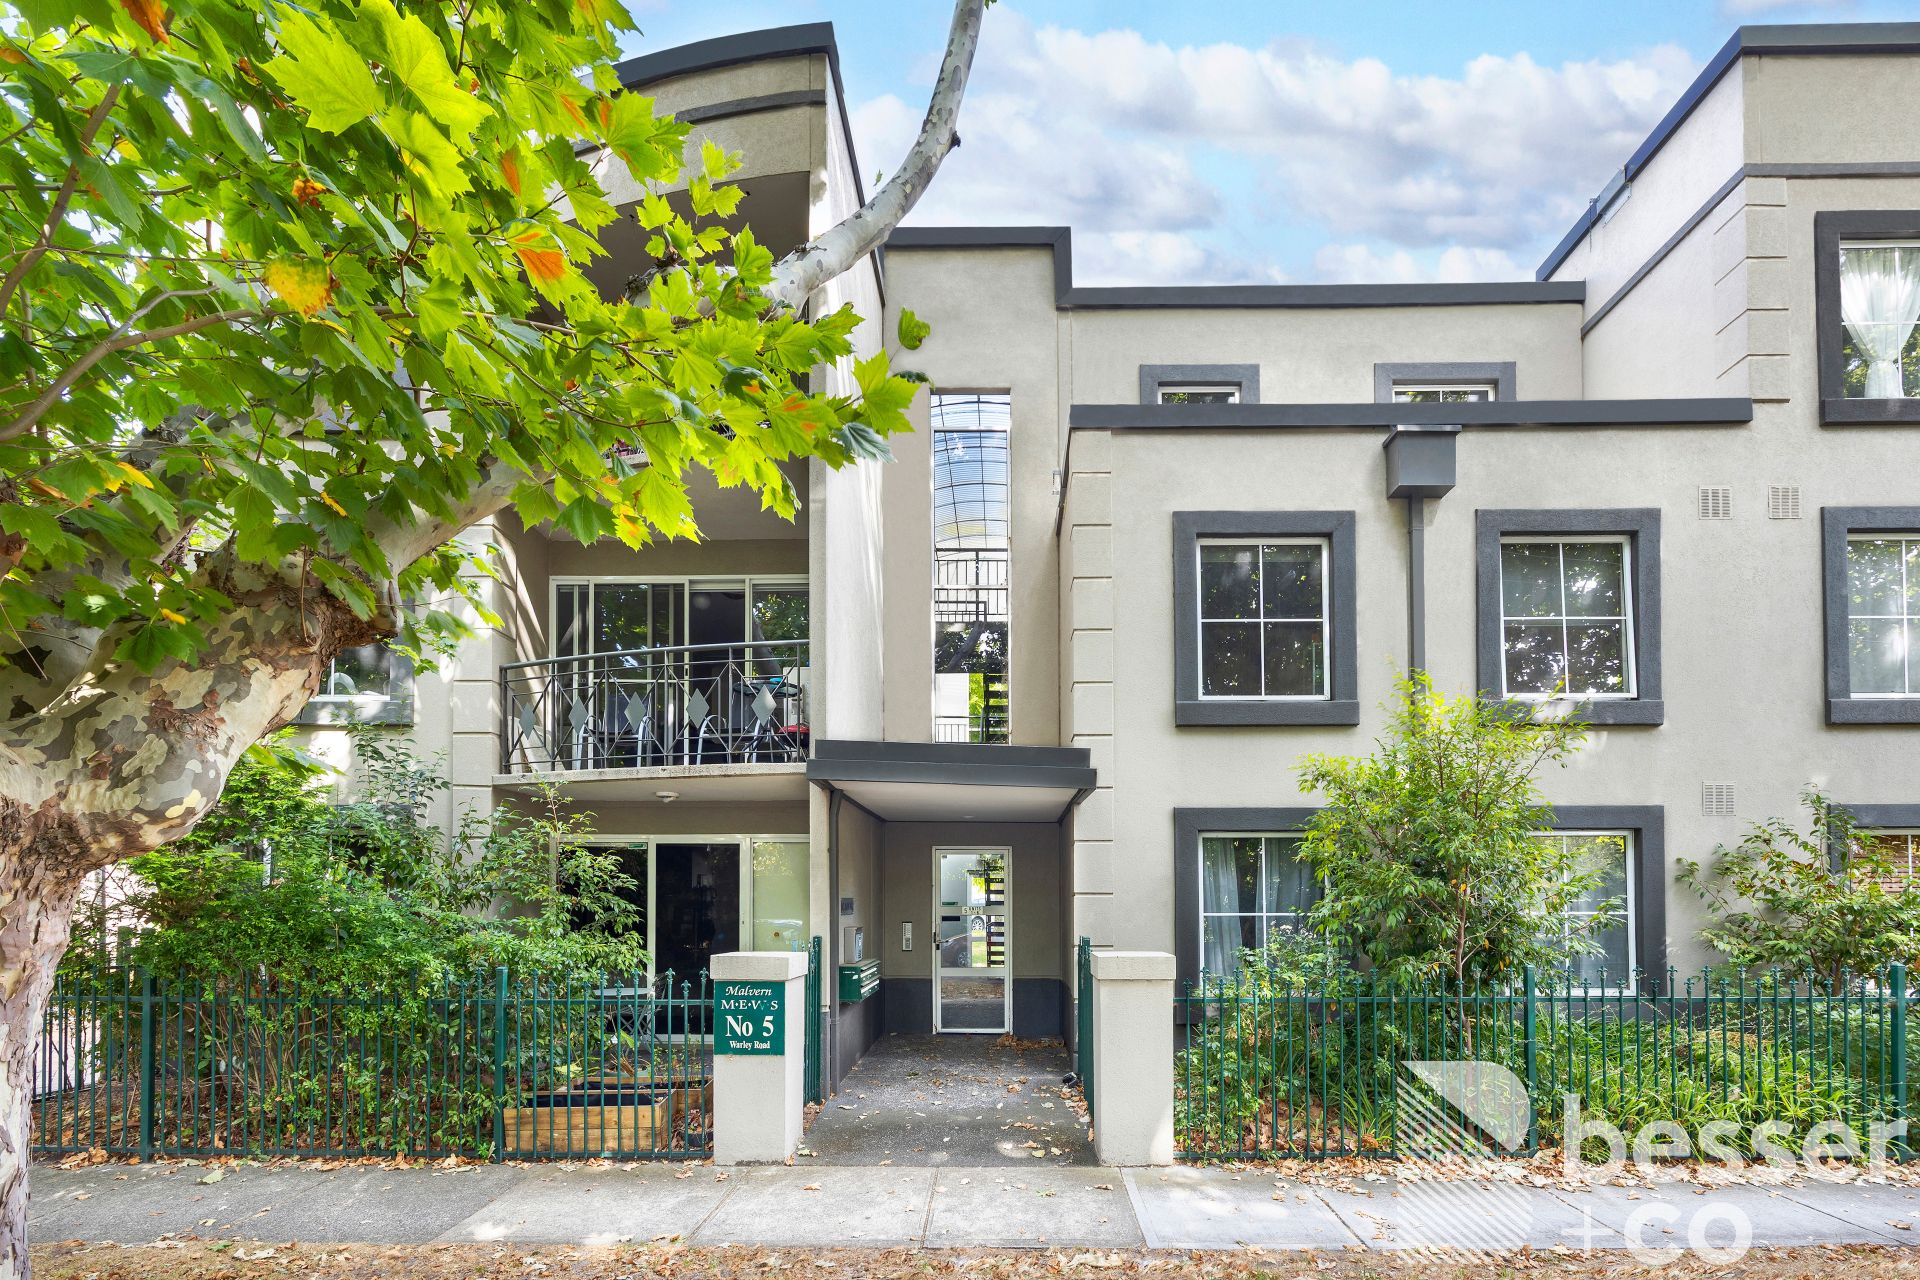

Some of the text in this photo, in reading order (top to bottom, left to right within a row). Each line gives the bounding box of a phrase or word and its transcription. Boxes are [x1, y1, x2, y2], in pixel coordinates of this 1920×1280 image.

[725, 985, 772, 996] Malvern
[725, 1015, 774, 1037] No 5
[729, 1040, 770, 1051] Warley Road
